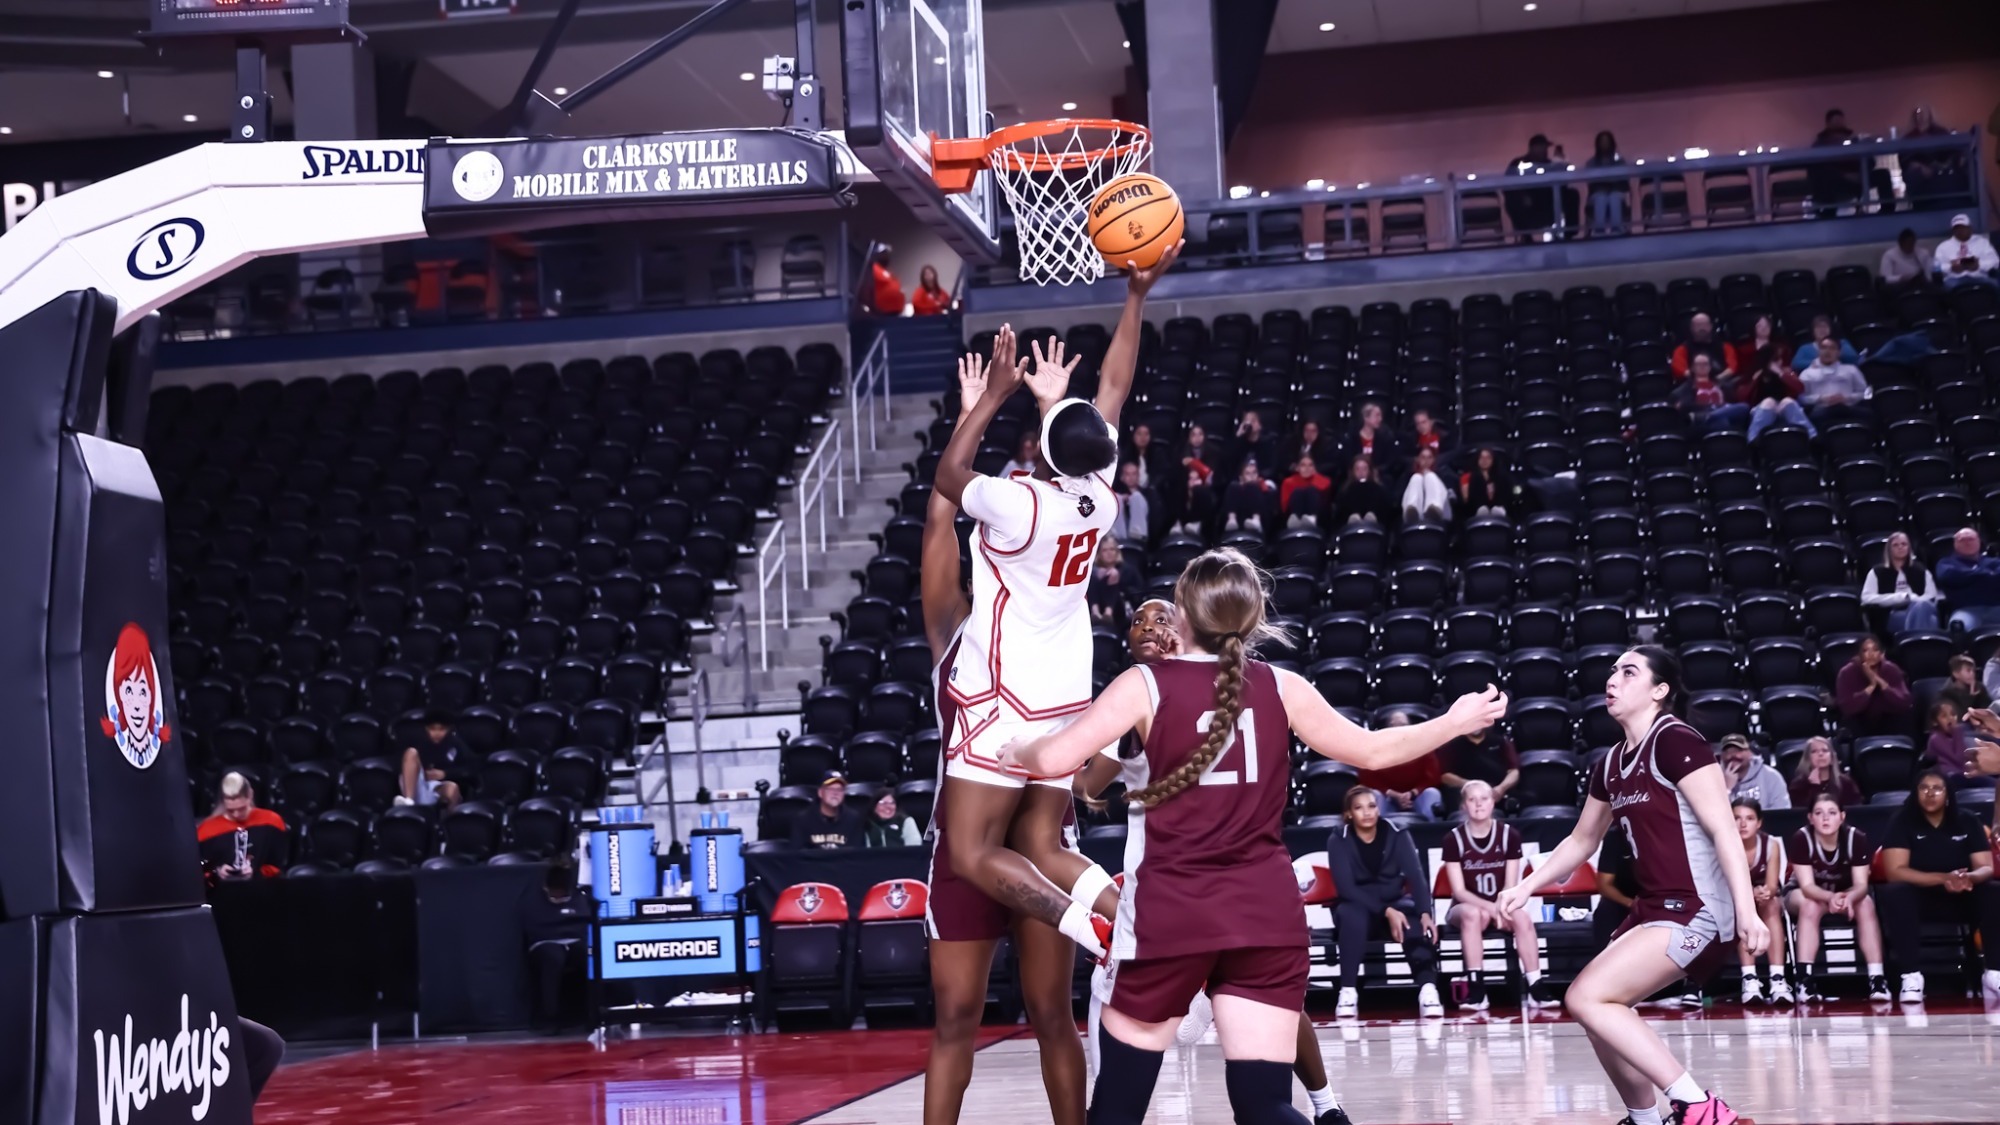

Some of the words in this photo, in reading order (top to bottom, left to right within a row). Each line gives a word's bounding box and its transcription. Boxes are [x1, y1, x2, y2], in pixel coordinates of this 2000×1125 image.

[583, 139, 737, 169] CLARKSVILLE
[513, 171, 599, 198] MOBILE
[605, 168, 648, 194] MIX
[654, 169, 671, 191] &
[677, 160, 807, 191] MATERIALS
[1094, 183, 1153, 218] Wilson
[1047, 528, 1100, 587] 12
[1196, 708, 1258, 785] 21
[608, 834, 620, 893] POWERADE
[706, 839, 717, 890] POWERADE
[1475, 873, 1497, 896] 10
[617, 939, 718, 960] POWERADE
[94, 993, 230, 1125] Wendy's
